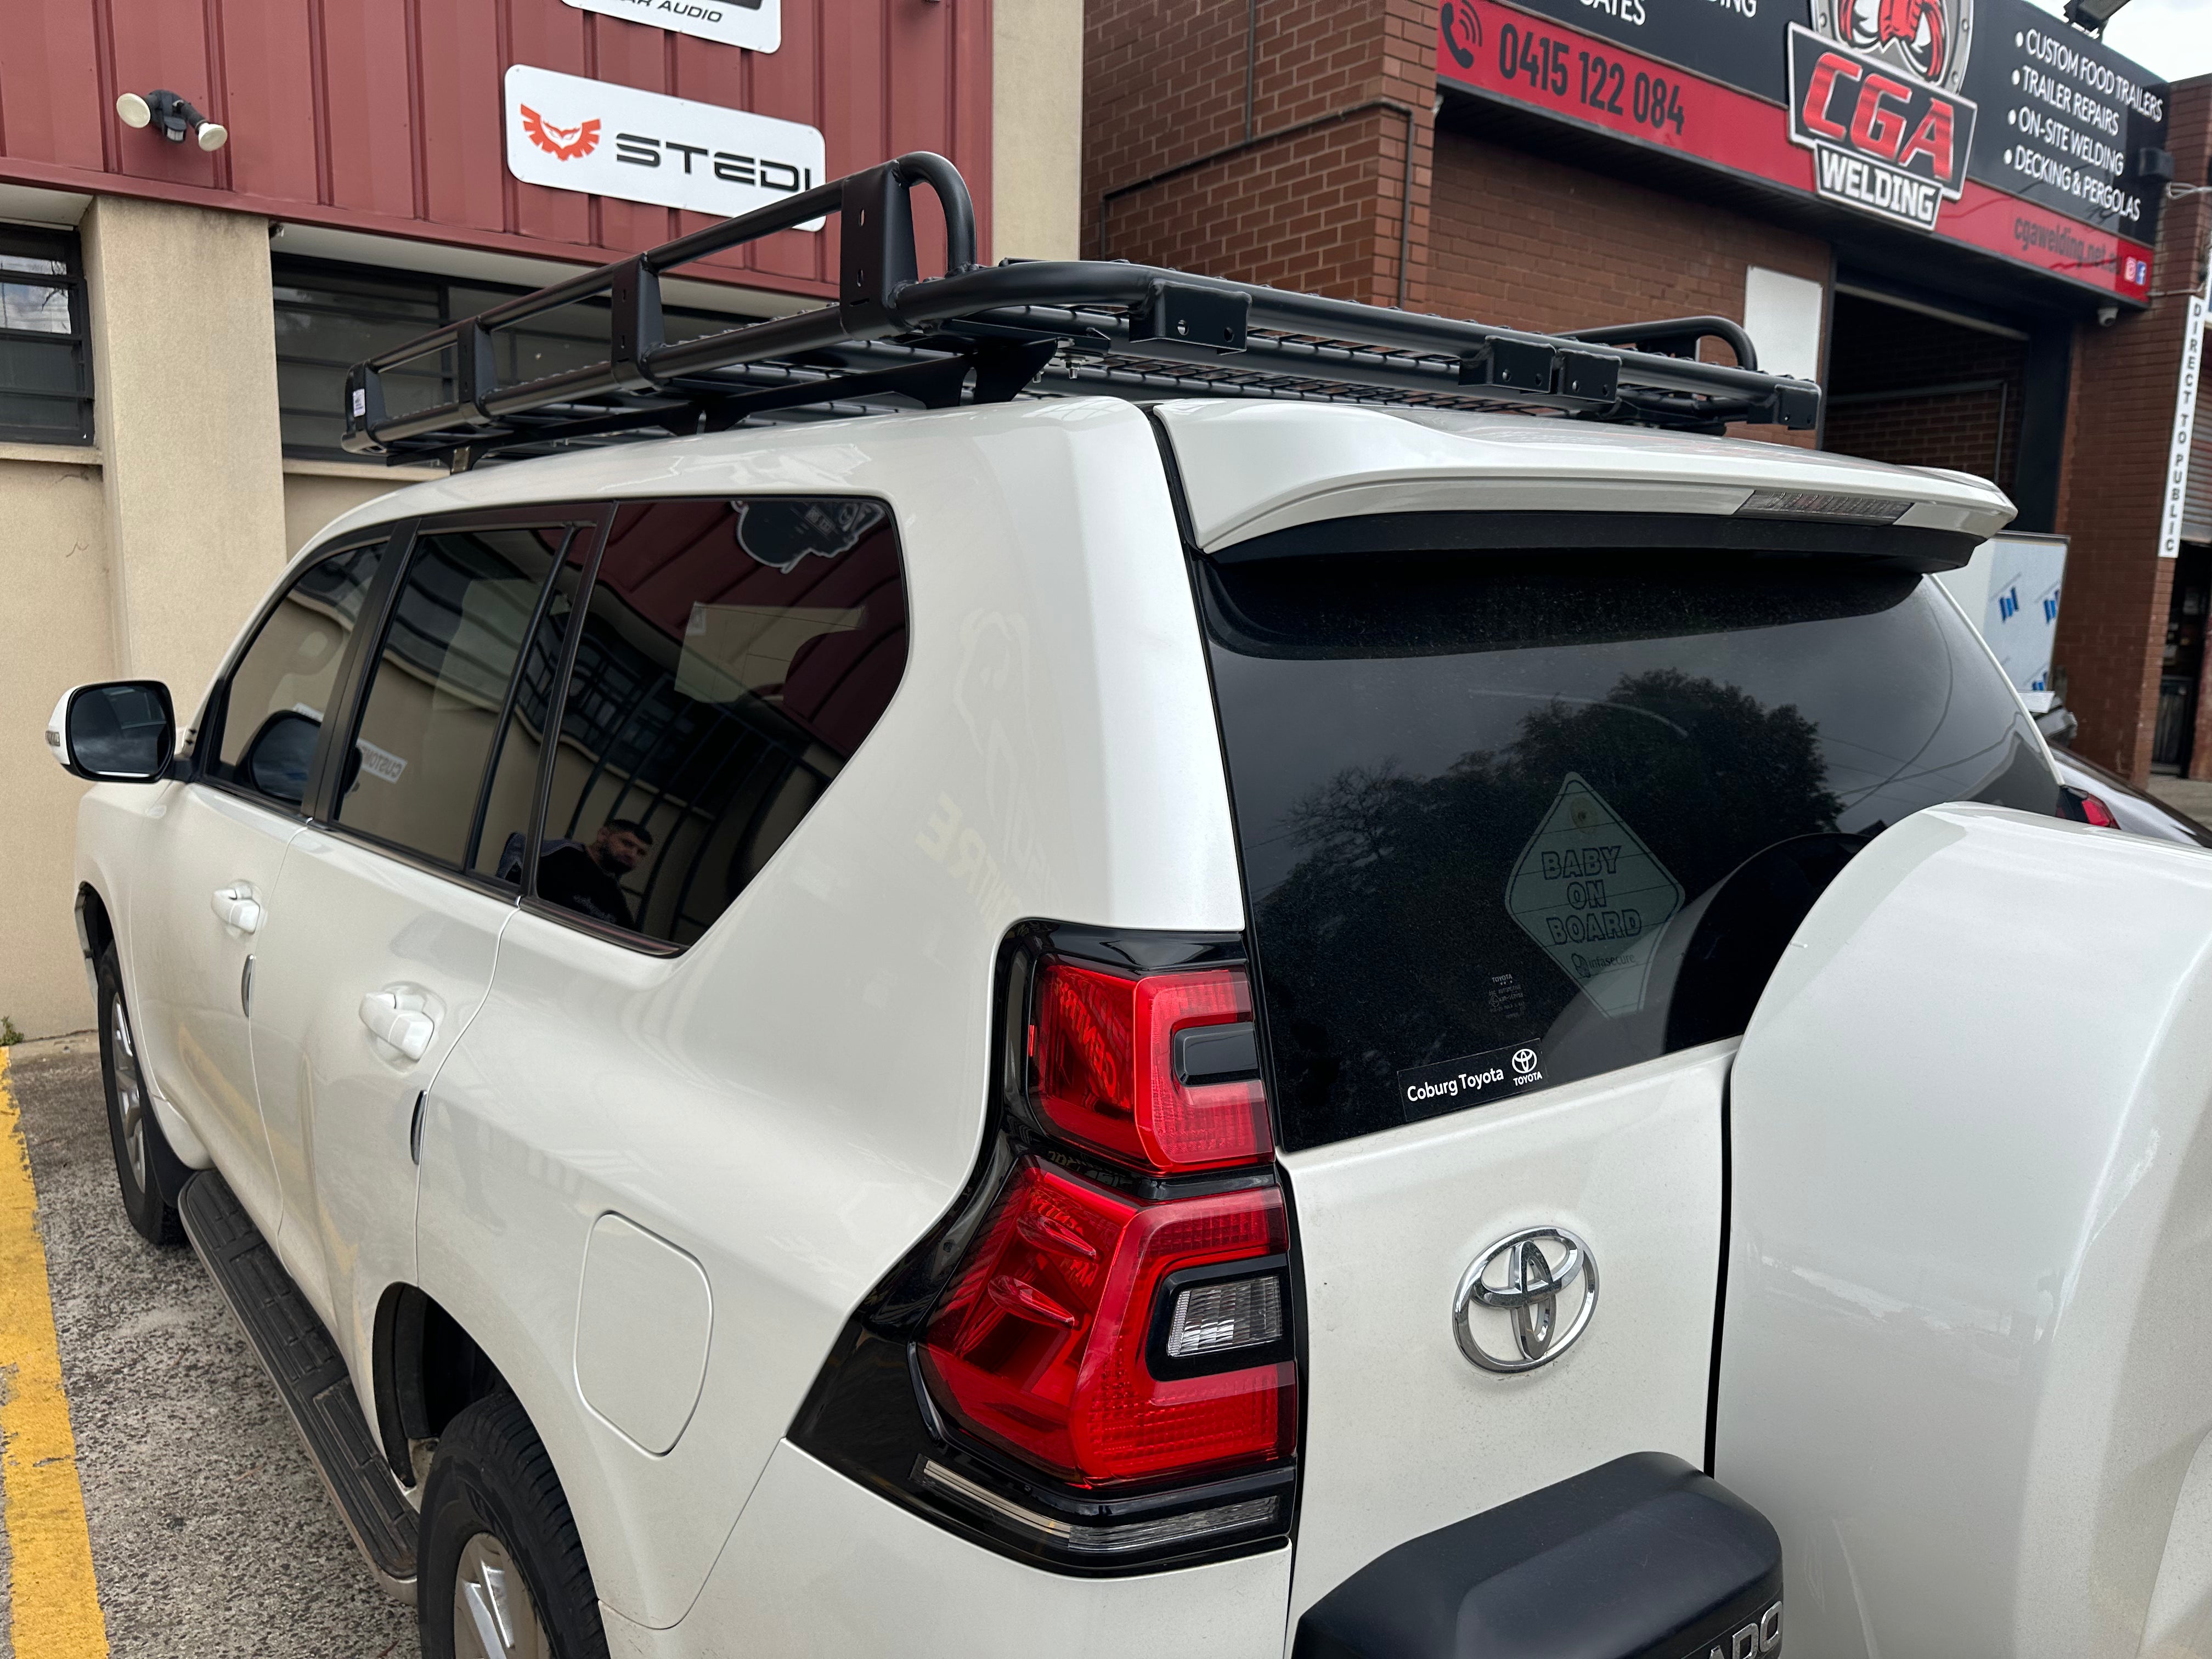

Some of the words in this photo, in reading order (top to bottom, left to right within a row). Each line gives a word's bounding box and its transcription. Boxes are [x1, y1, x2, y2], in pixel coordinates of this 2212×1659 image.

[657, 0, 723, 23] AUDIO
[1499, 23, 1569, 97] 0415
[1579, 52, 1625, 116] 122
[1633, 72, 1685, 136] 084
[2023, 65, 2072, 114] TRAILER
[2072, 92, 2119, 137] REPAIRS
[2025, 28, 2079, 78] CUSTOM
[2079, 57, 2115, 95] FOOD
[2115, 75, 2163, 123] TRAILERS
[1803, 52, 1954, 182] CGA
[2018, 106, 2069, 151] ON-SITE
[2069, 129, 2124, 177] WELDING
[616, 133, 811, 192] STEDI
[1821, 149, 1936, 221] WELDING
[2014, 144, 2072, 191] DECKING
[2072, 171, 2082, 196] &
[2083, 176, 2141, 222] PERGOLAS
[2182, 303, 2202, 405] DIRECT
[2177, 414, 2188, 444] TO
[2165, 454, 2183, 552] PUBLIC
[1541, 845, 1622, 880] BABY
[1567, 879, 1607, 909] ON
[1546, 909, 1643, 945] BOARD
[1492, 974, 1513, 983] TOYOTA
[1407, 1077, 1458, 1101] Coburg
[1458, 1069, 1504, 1091] Toyota
[1513, 1071, 1543, 1086] TOYOTA
